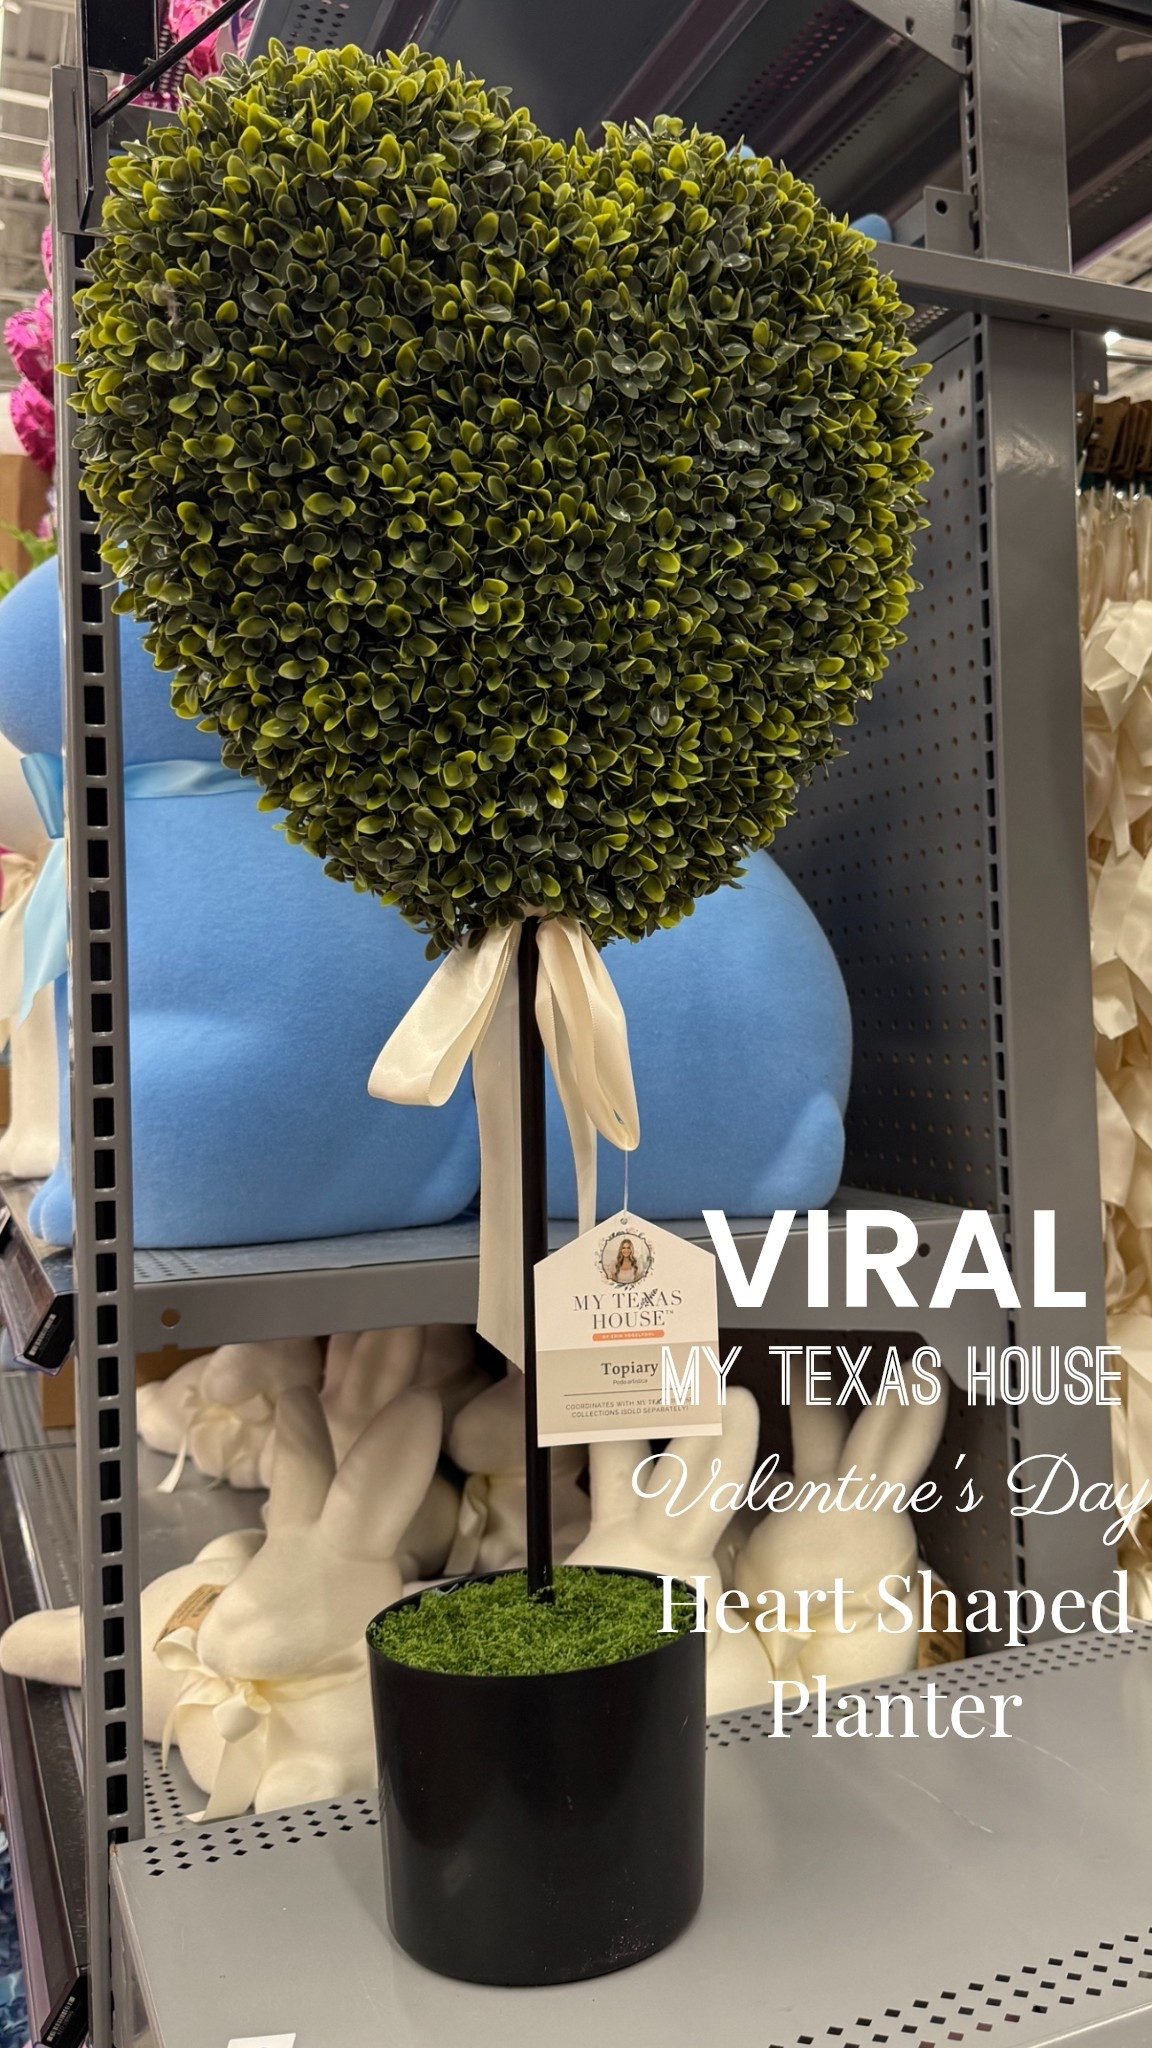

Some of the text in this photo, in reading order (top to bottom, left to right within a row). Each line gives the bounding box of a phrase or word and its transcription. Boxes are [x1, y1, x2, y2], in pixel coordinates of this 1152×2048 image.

[573, 1289, 683, 1312] MY TEXAS
[601, 1361, 658, 1378] Topiary
[566, 1401, 614, 1409] COORDINATES
